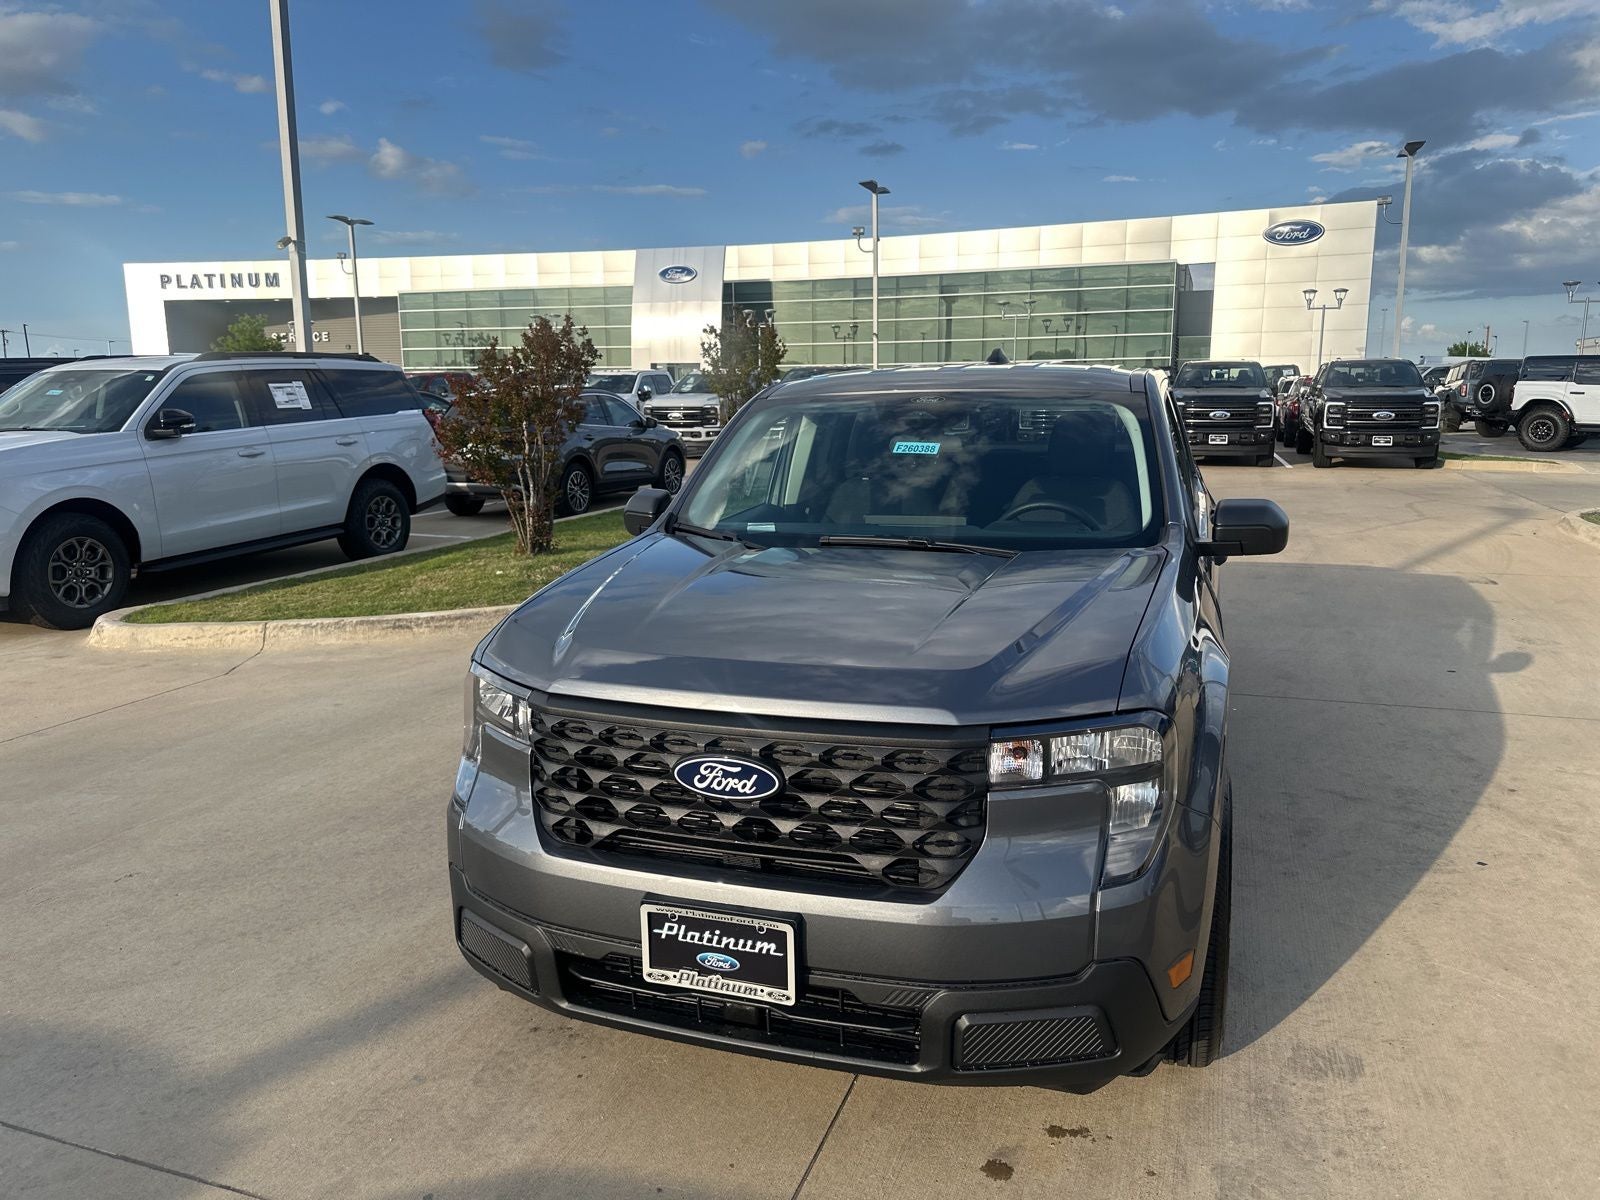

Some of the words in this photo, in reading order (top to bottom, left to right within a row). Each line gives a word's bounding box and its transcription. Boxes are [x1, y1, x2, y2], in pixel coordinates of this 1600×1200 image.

[160, 272, 281, 289] PLATINUM
[271, 330, 329, 342] SERCE
[895, 444, 936, 453] F260388
[693, 762, 758, 794] Ford
[652, 922, 784, 957] Platinum
[704, 955, 731, 969] Ford
[677, 972, 765, 998] Platinum
